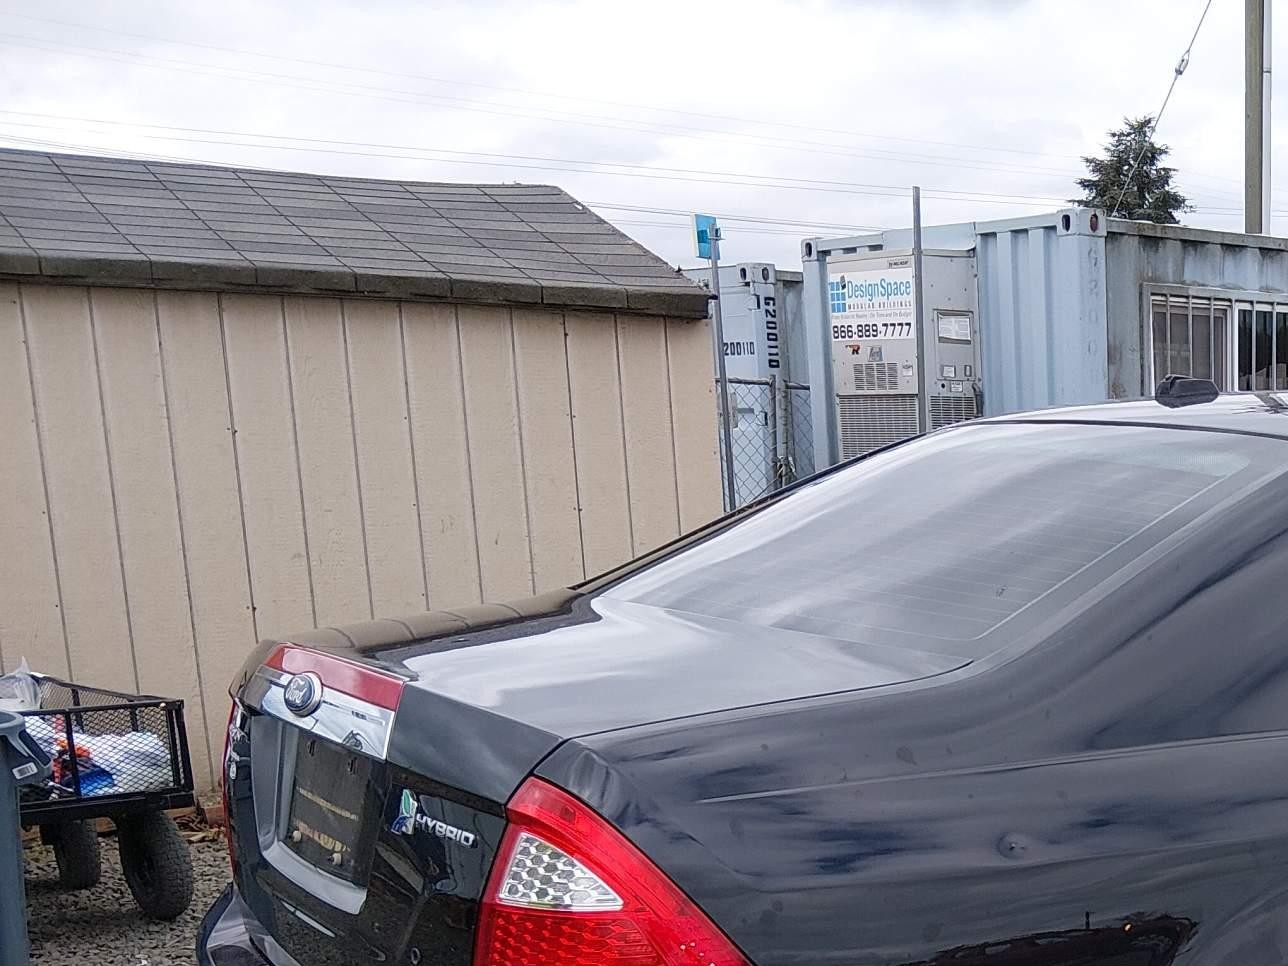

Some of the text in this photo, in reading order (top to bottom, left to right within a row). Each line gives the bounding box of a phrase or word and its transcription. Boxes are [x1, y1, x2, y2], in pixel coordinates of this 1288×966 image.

[847, 278, 912, 301] DesignSpace
[764, 296, 780, 368] G200110
[723, 342, 755, 356] 200110
[416, 813, 476, 847] HYBRID
